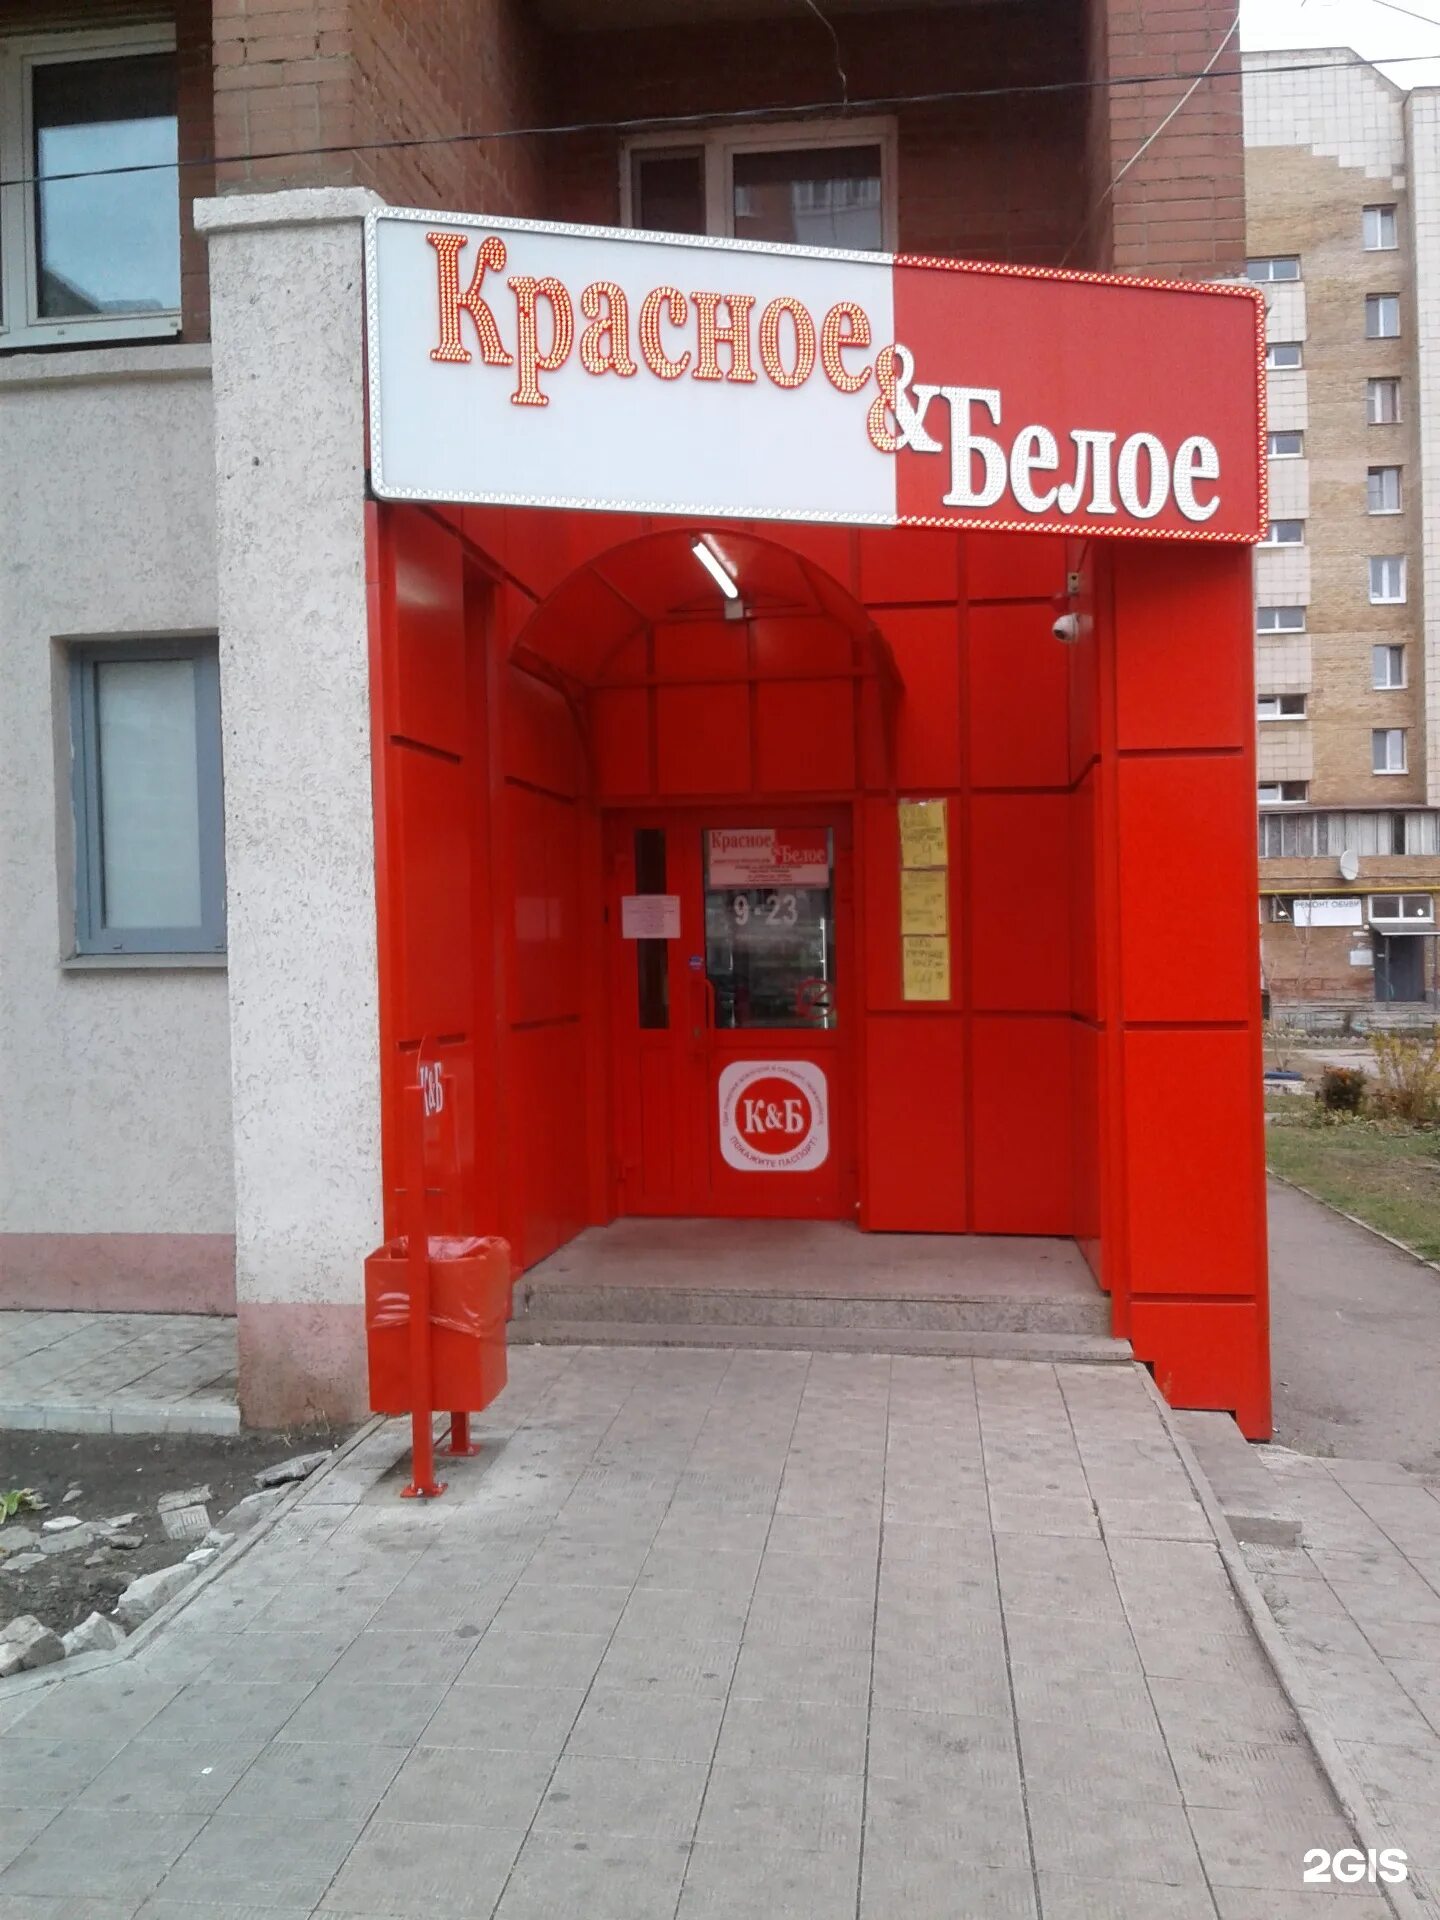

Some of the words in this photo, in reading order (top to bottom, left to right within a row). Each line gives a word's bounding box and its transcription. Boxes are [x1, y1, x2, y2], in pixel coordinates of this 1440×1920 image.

[426, 231, 872, 406] Красное
[941, 385, 1221, 522] Белое
[711, 831, 771, 853] Красное
[743, 1098, 804, 1133] К&Б
